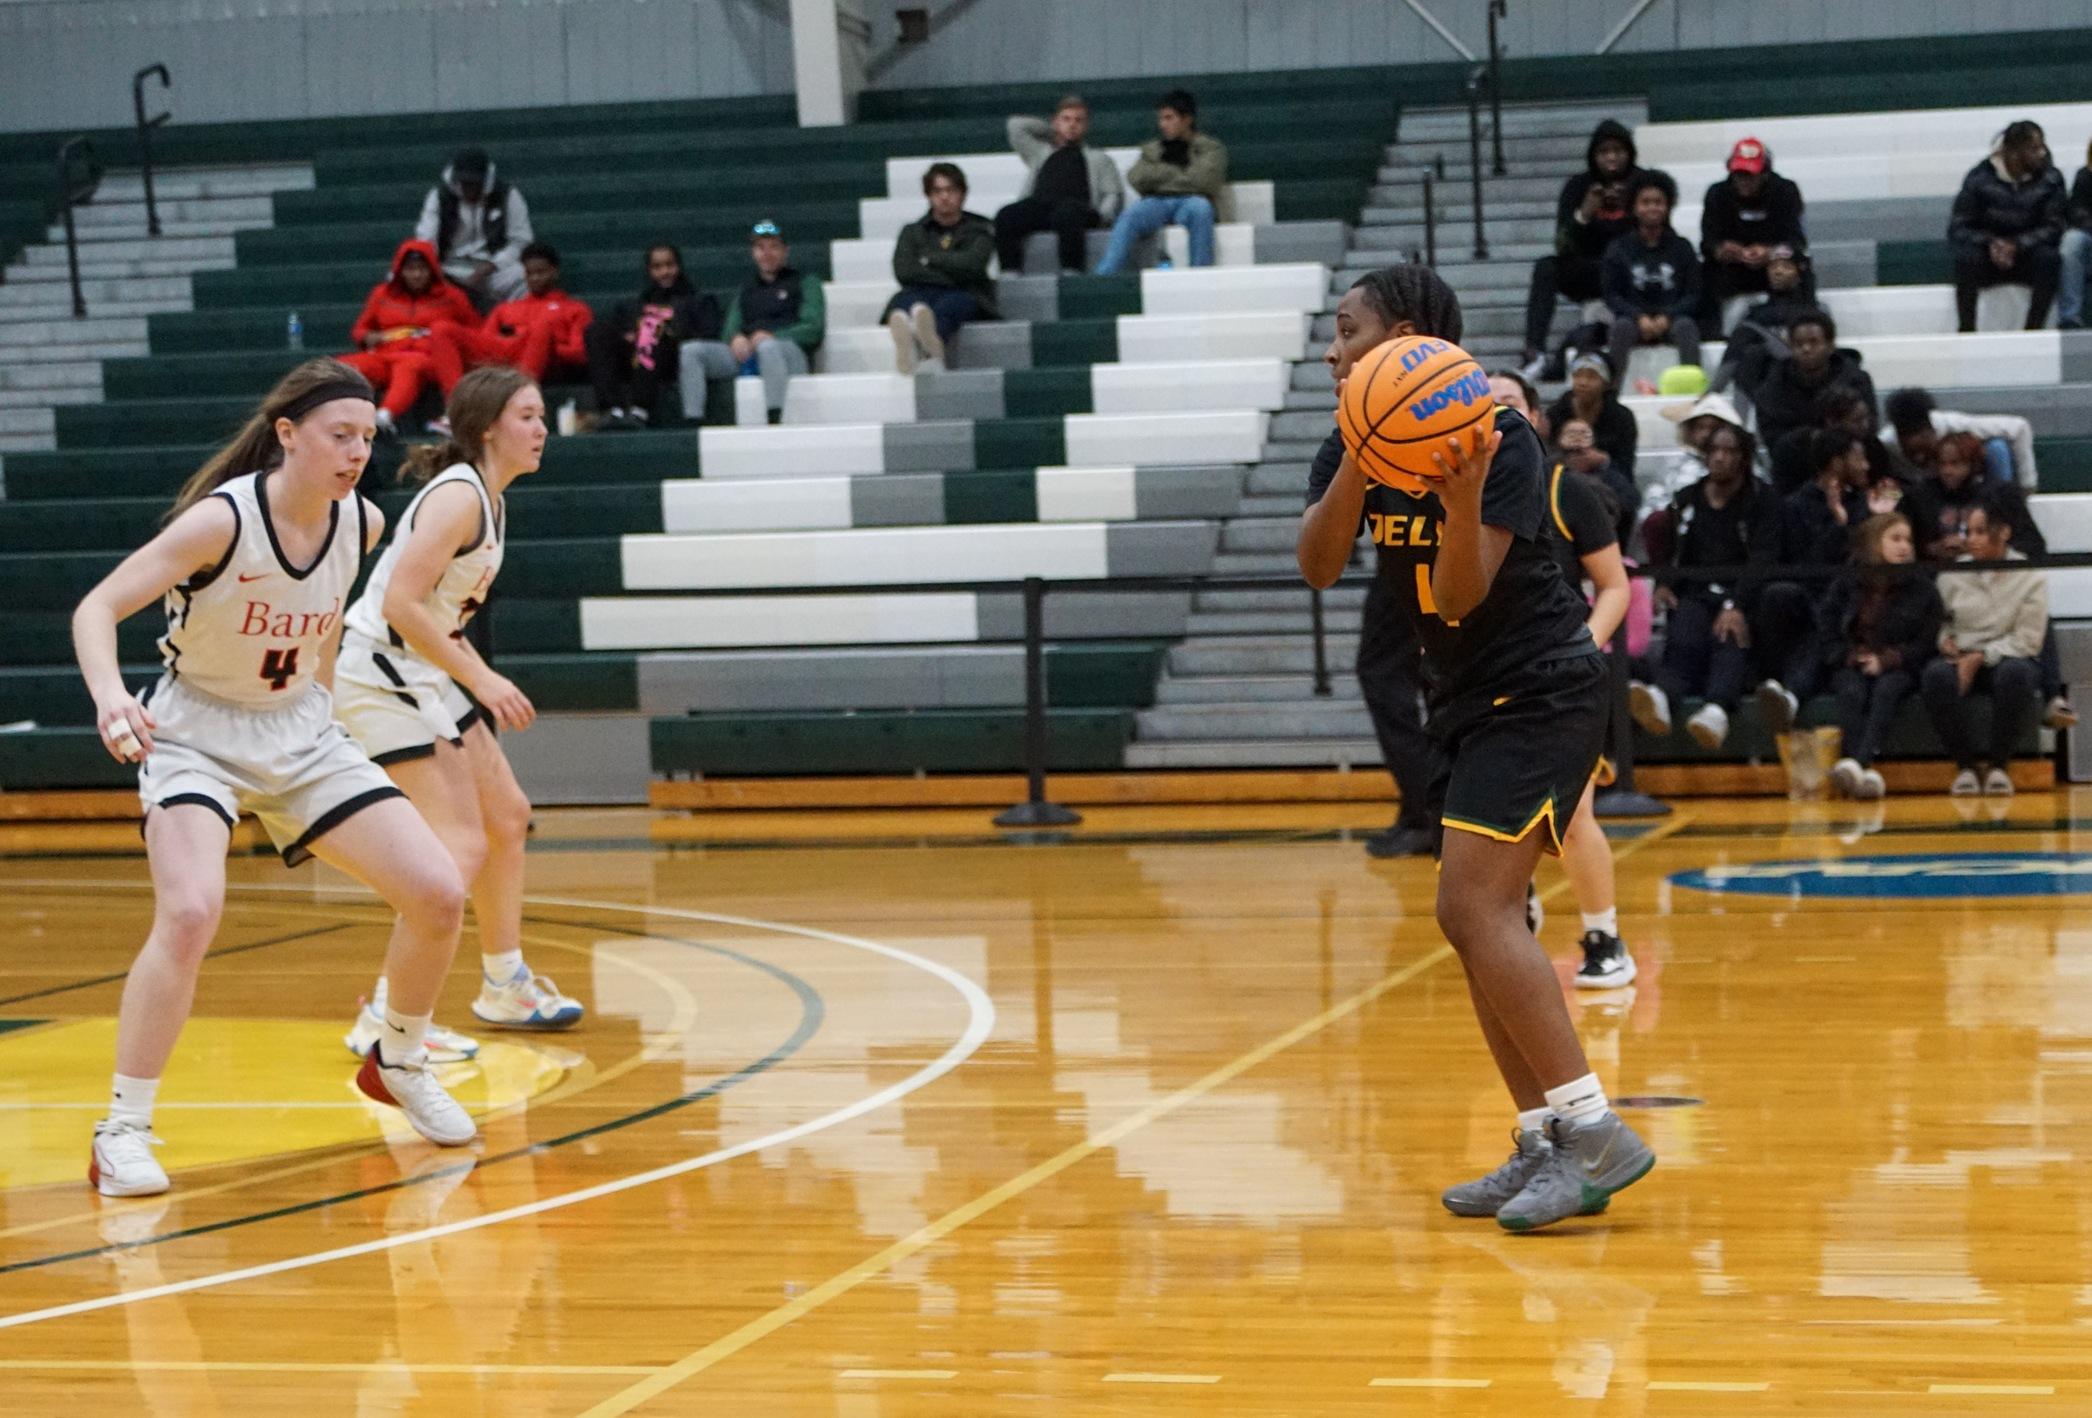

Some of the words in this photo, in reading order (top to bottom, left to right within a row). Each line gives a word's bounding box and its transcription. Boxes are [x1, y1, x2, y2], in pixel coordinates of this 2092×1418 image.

[1409, 368, 1491, 422] Wilson
[1368, 513, 1445, 547] DEL
[237, 597, 341, 638] Bard
[258, 646, 300, 691] 4
